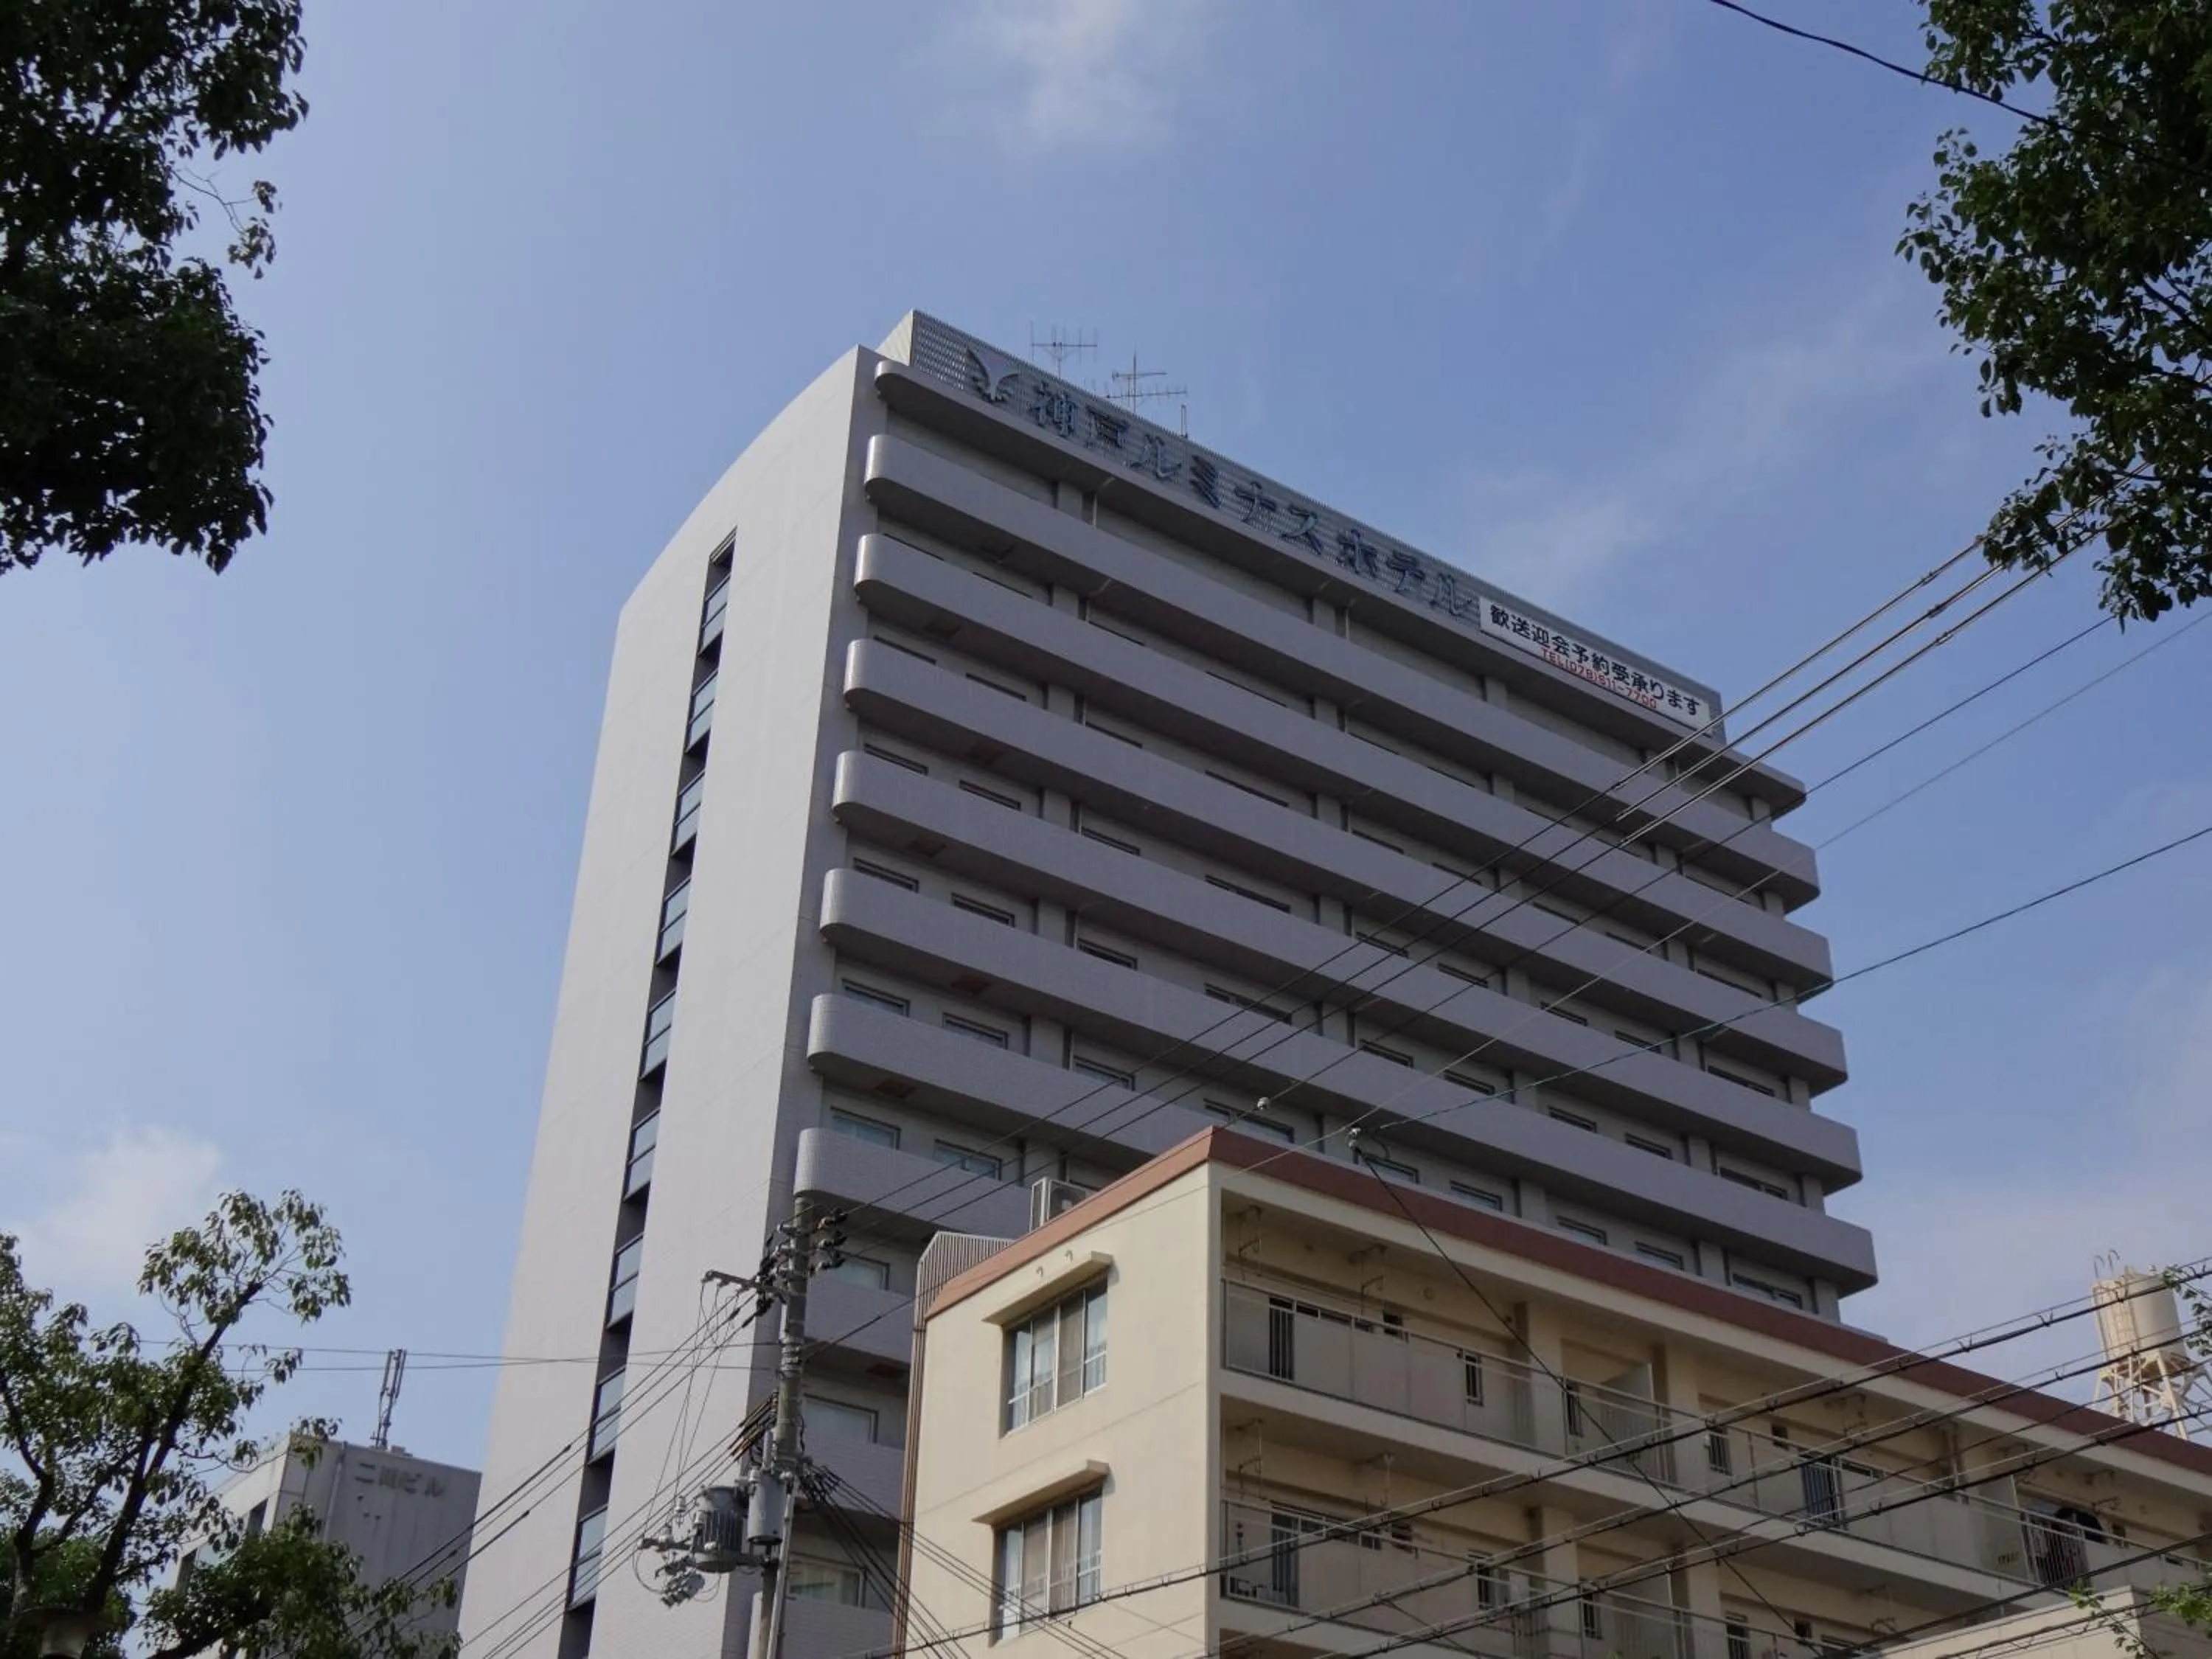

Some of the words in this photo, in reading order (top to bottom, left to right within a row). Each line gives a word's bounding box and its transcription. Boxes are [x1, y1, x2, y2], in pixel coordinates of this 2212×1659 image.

[1027, 379, 1473, 618] 神戸ルミナスホテル
[1490, 604, 1700, 716] 歓送迎会予約受承ります
